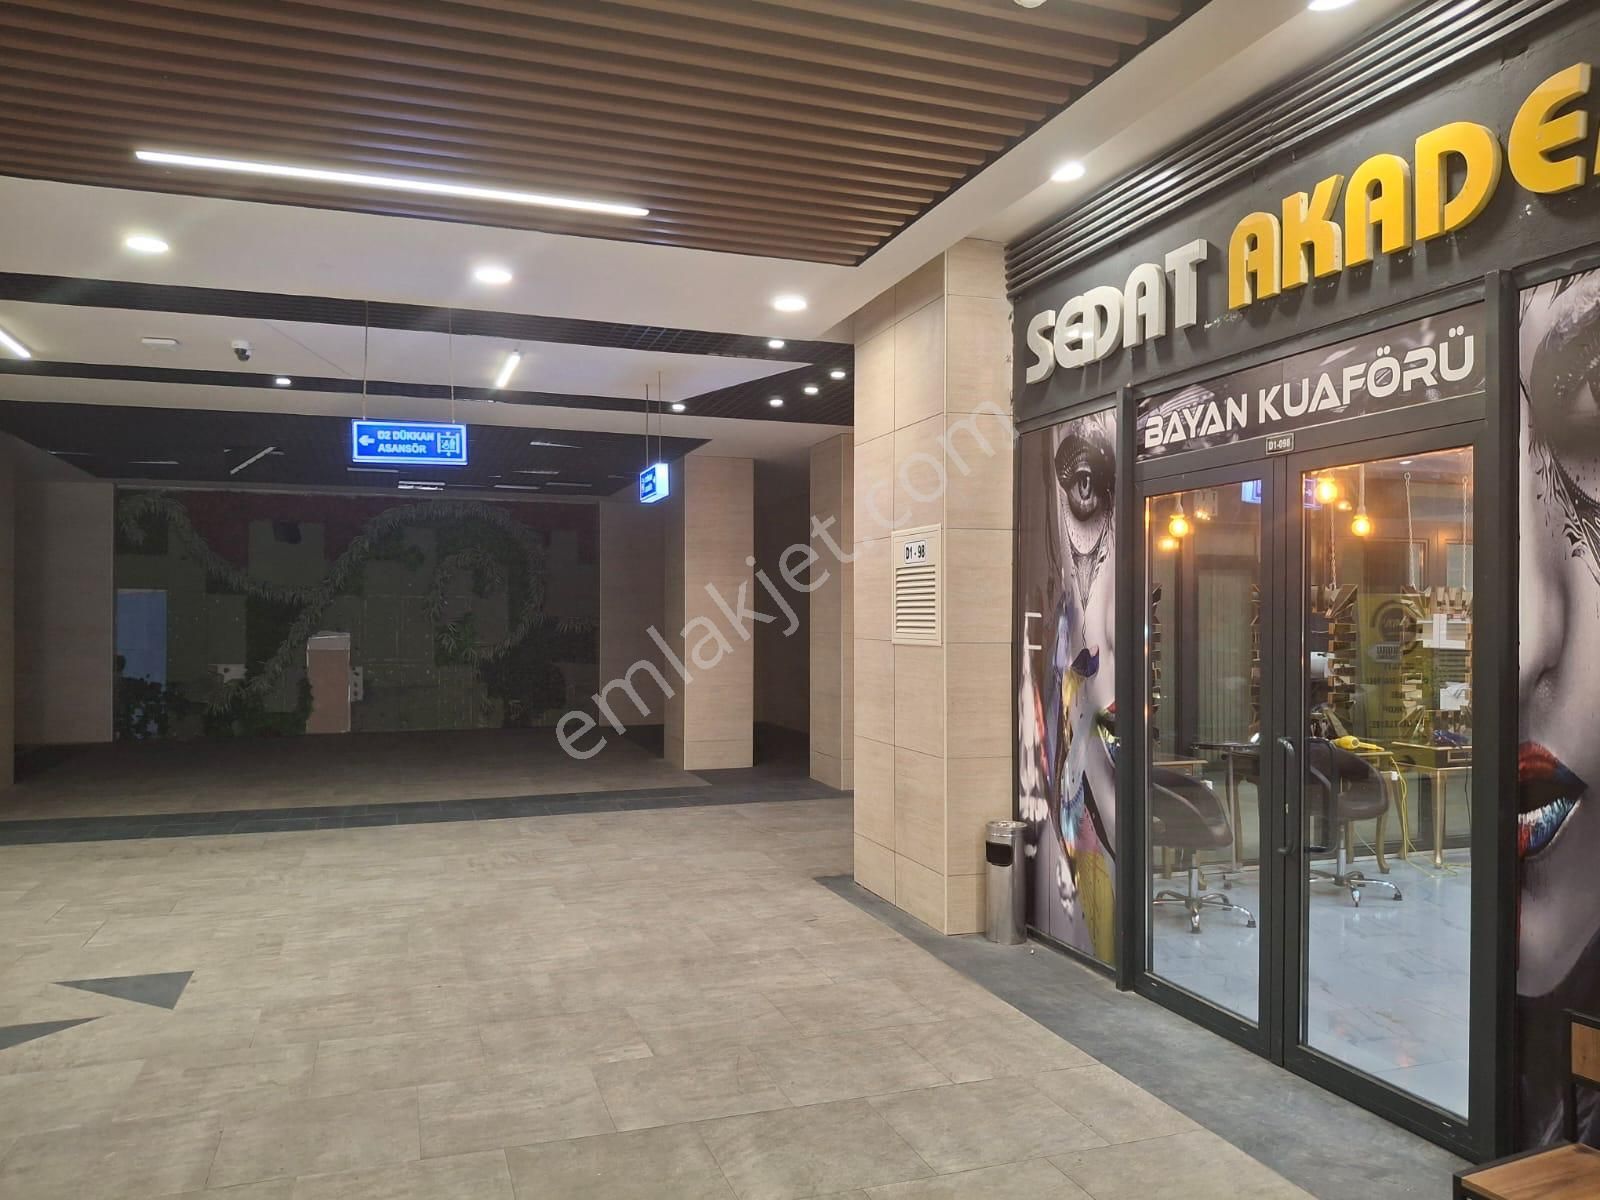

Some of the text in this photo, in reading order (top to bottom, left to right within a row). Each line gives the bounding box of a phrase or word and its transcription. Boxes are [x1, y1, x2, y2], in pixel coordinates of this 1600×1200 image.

[1026, 62, 1600, 384] SEDAT AKADE
[1144, 325, 1475, 449] BAYAN KUAFÖRÜ
[393, 429, 435, 441] DÜKKAN
[377, 442, 427, 454] ASANSÖR
[905, 546, 913, 560] D1
